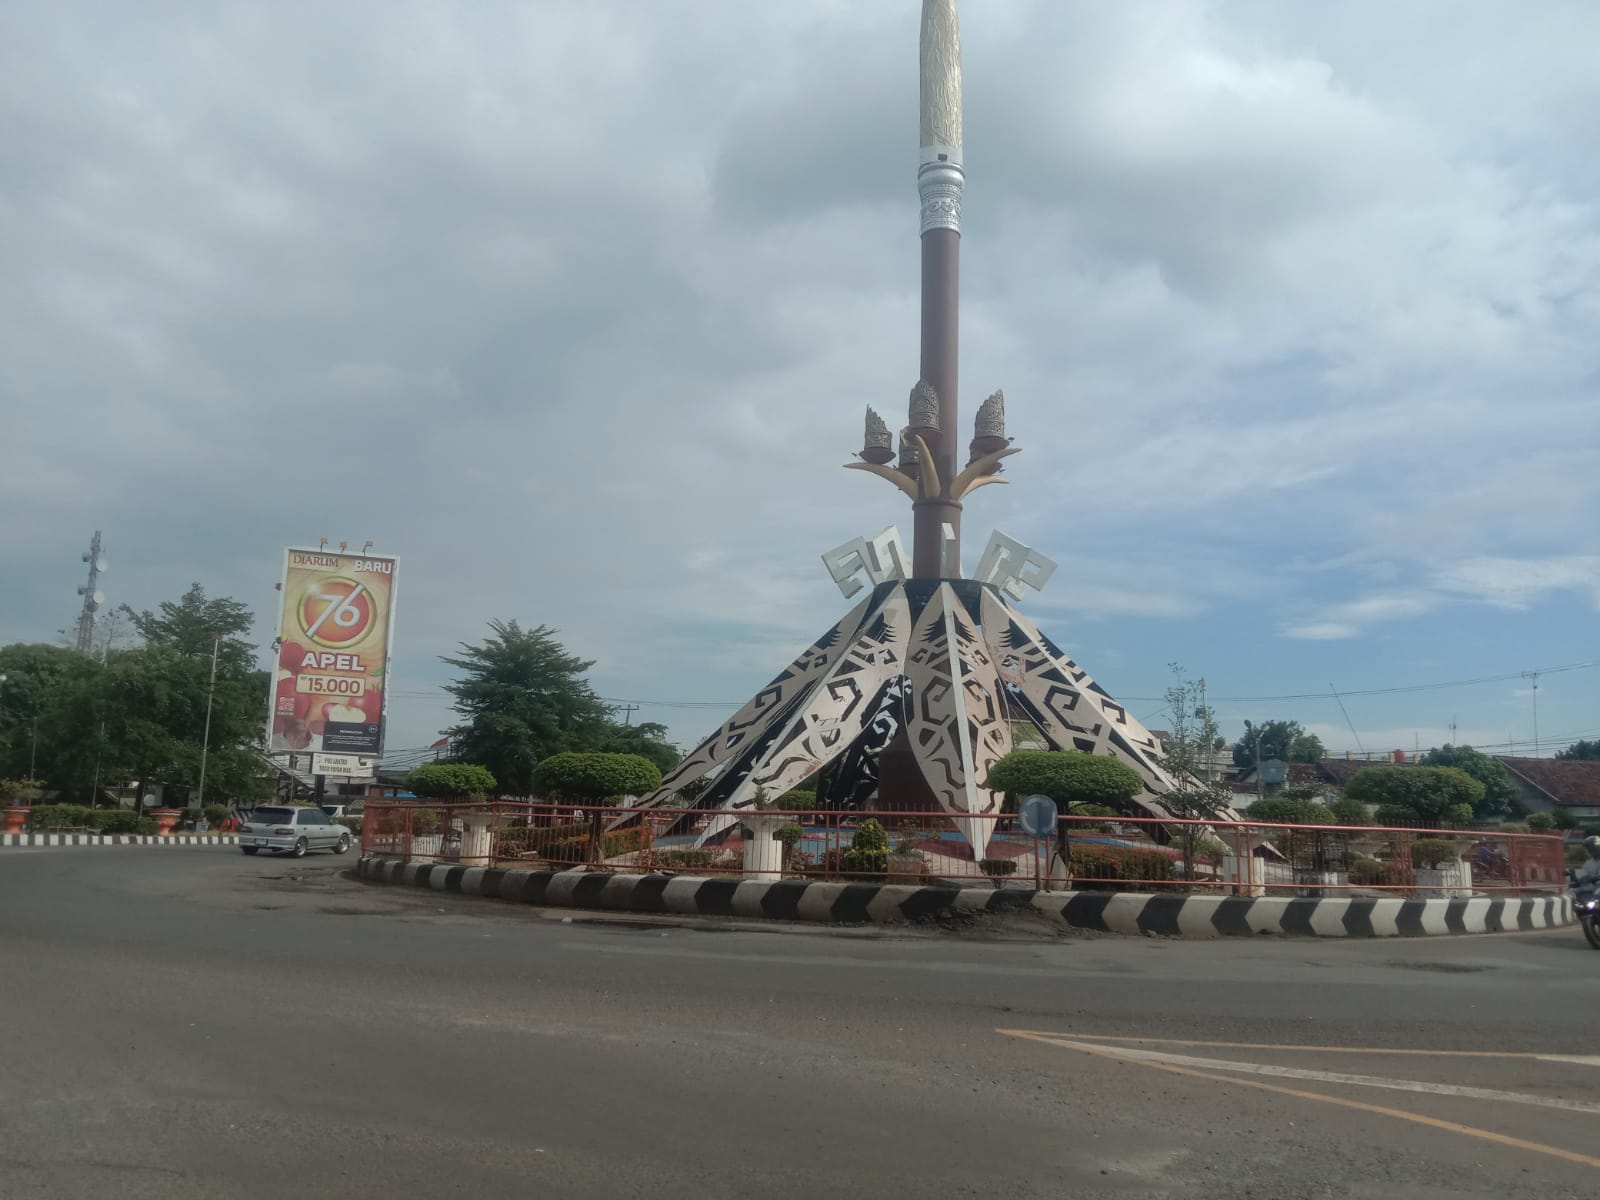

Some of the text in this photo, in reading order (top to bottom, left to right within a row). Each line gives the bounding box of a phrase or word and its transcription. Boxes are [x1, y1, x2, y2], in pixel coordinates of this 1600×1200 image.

[293, 554, 339, 568] DJARUM
[354, 560, 392, 574] BARU
[306, 583, 365, 638] 76
[300, 652, 365, 672] APEL
[308, 677, 361, 694] 15.000
